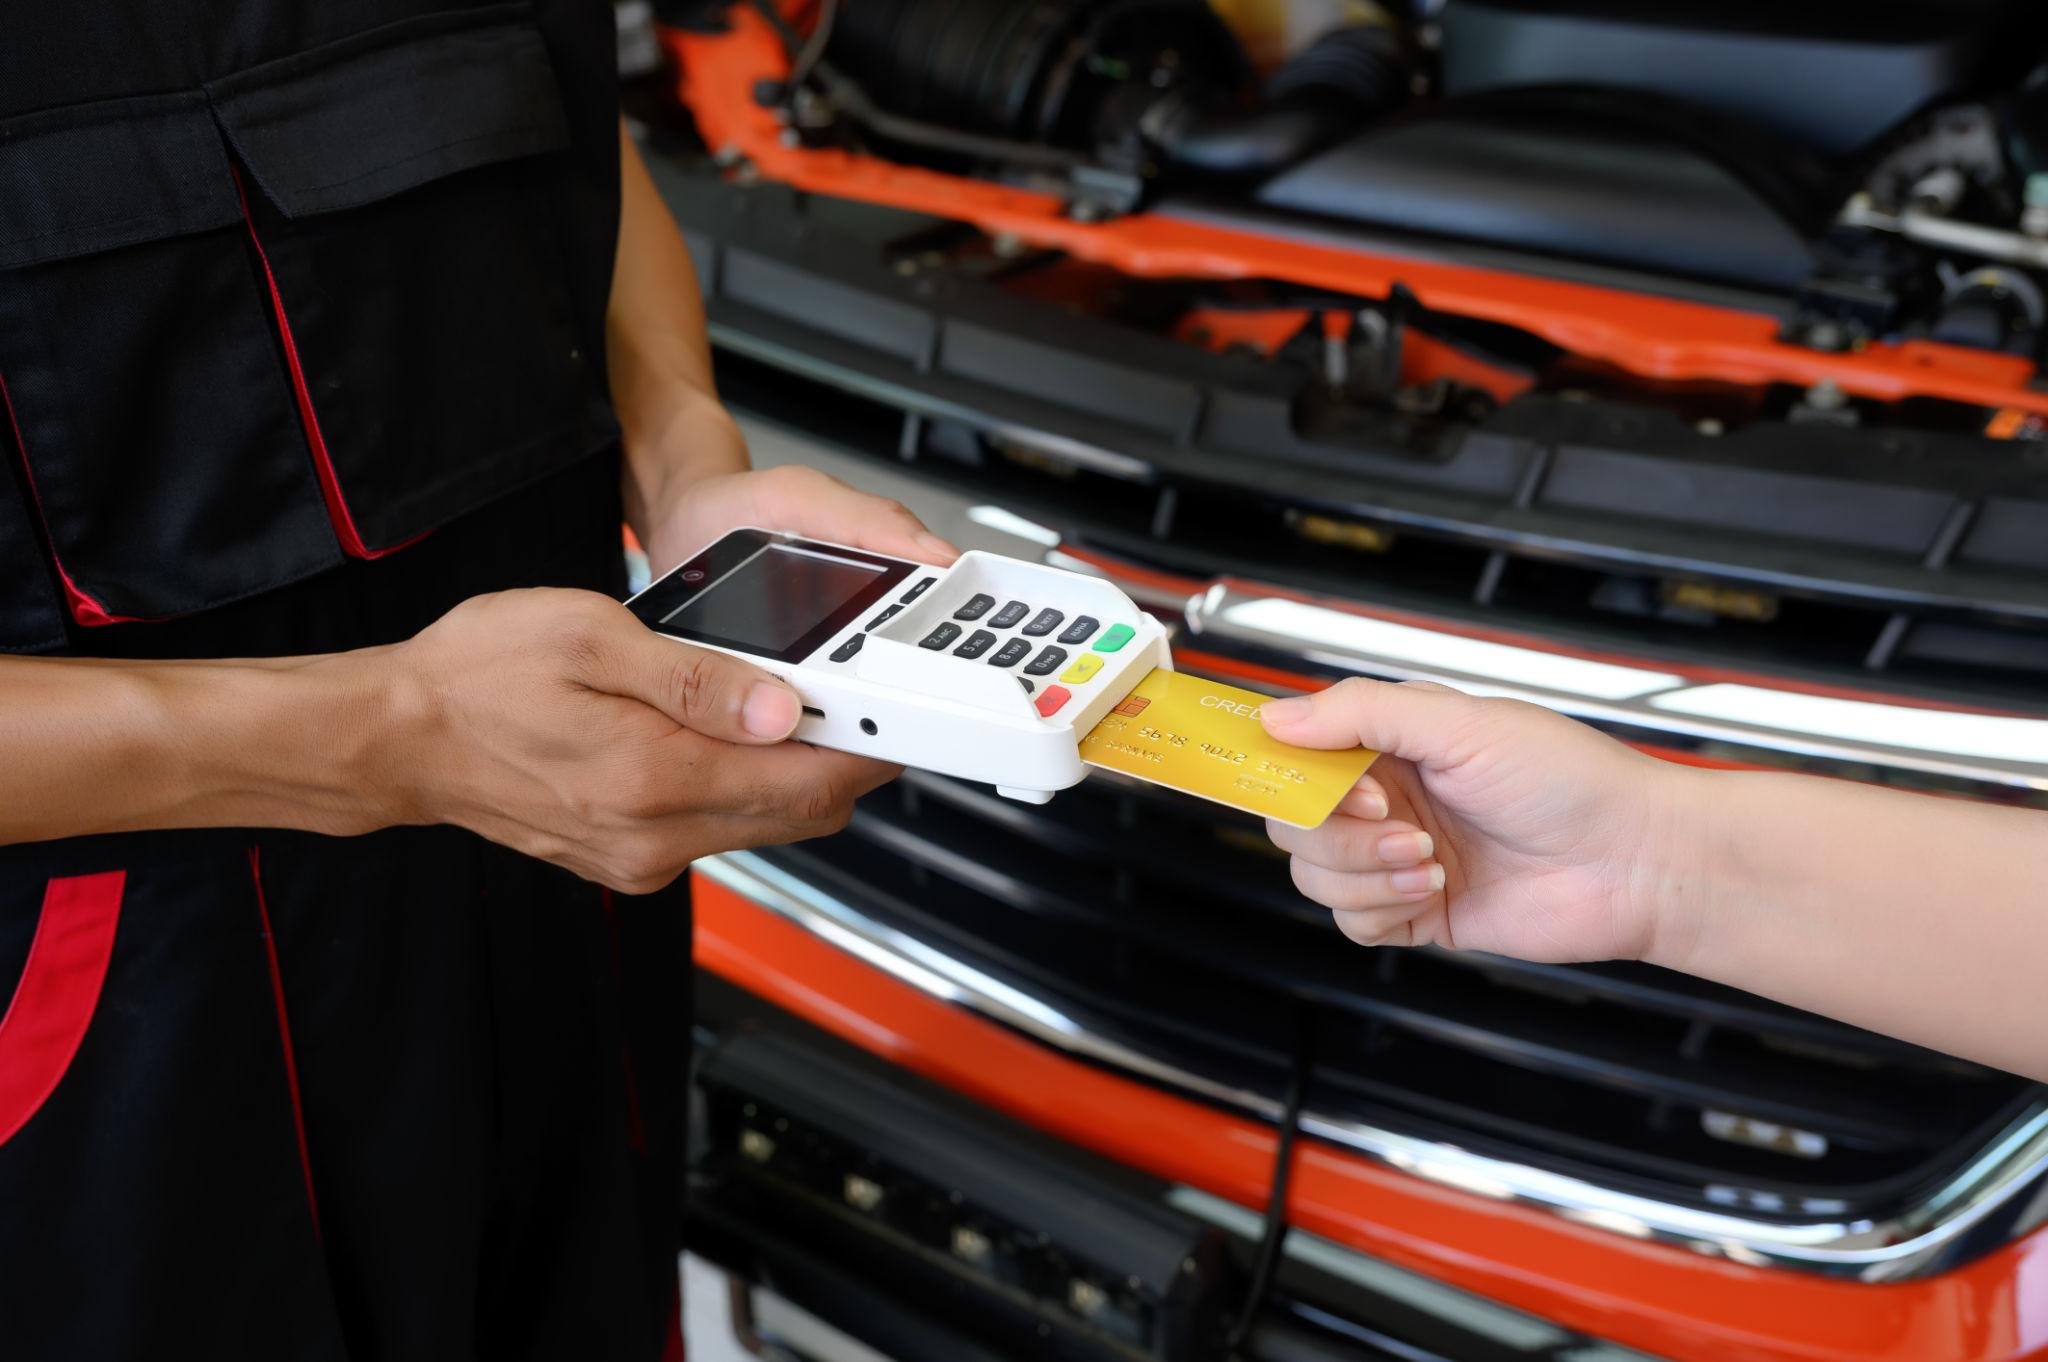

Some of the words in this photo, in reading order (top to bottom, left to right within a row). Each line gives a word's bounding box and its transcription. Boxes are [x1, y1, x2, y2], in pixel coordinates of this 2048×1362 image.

[963, 608, 976, 616] 3
[1069, 622, 1089, 637] ALPHA
[928, 637, 941, 645] 2
[938, 628, 953, 640] ABC
[1007, 644, 1022, 656] TUV
[1035, 661, 1048, 669] 0
[1199, 742, 1248, 767] 9012
[1256, 760, 1307, 784] 3456
